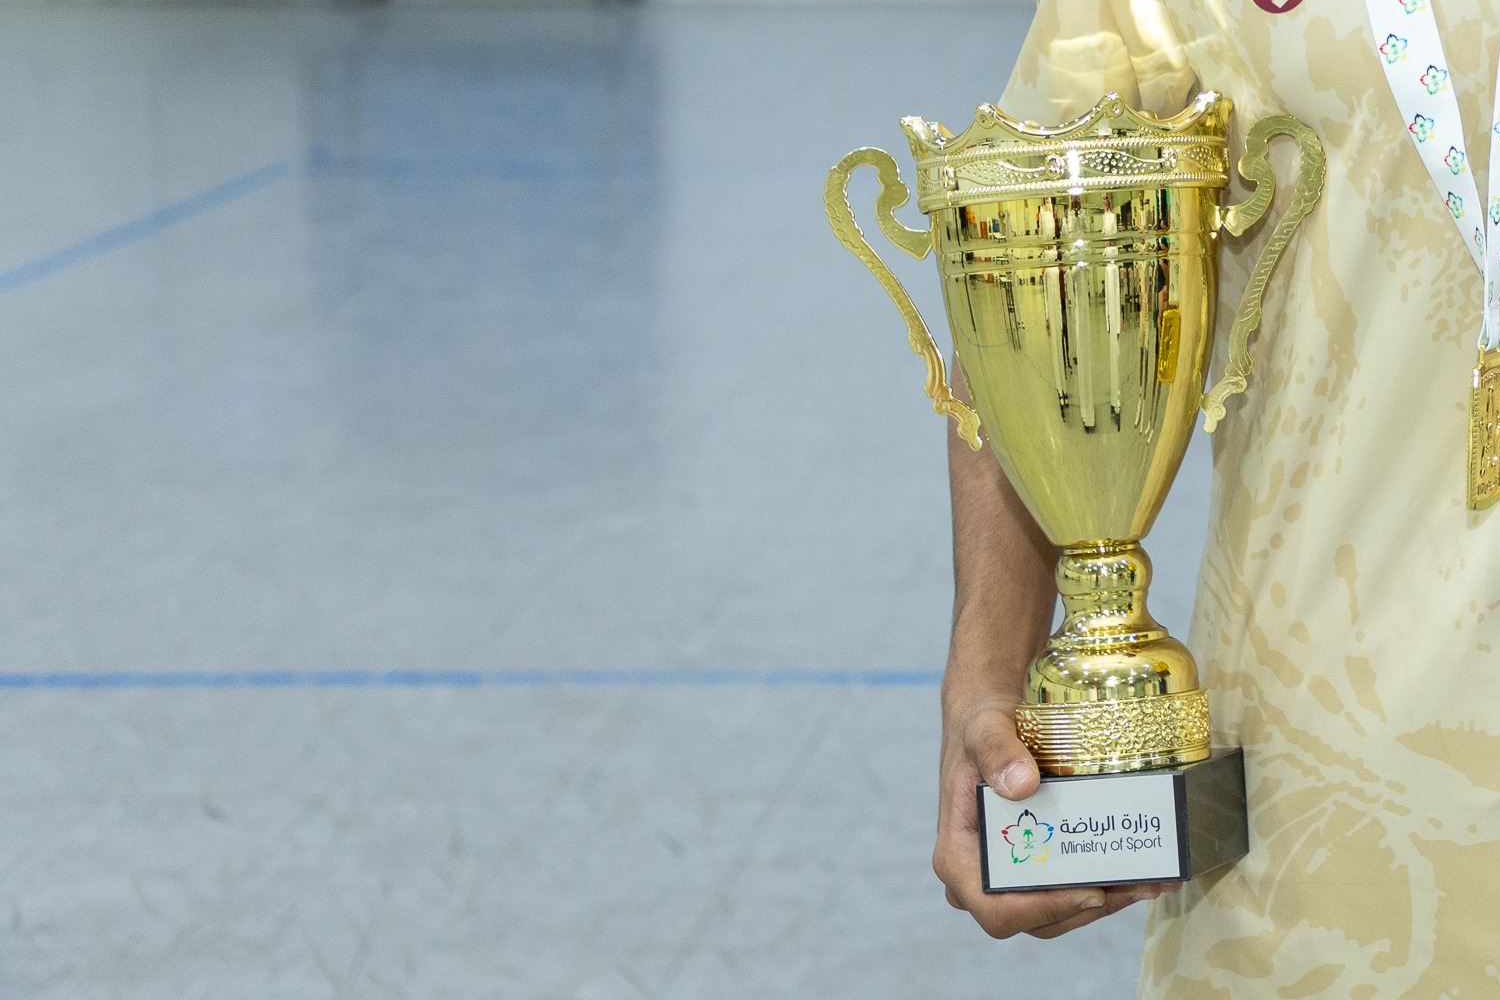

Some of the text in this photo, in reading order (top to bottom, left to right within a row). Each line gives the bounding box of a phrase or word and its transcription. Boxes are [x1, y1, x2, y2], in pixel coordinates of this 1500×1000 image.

[1059, 813, 1161, 837] وزارة الرياضة
[1060, 834, 1162, 855] Ministry of Sport
